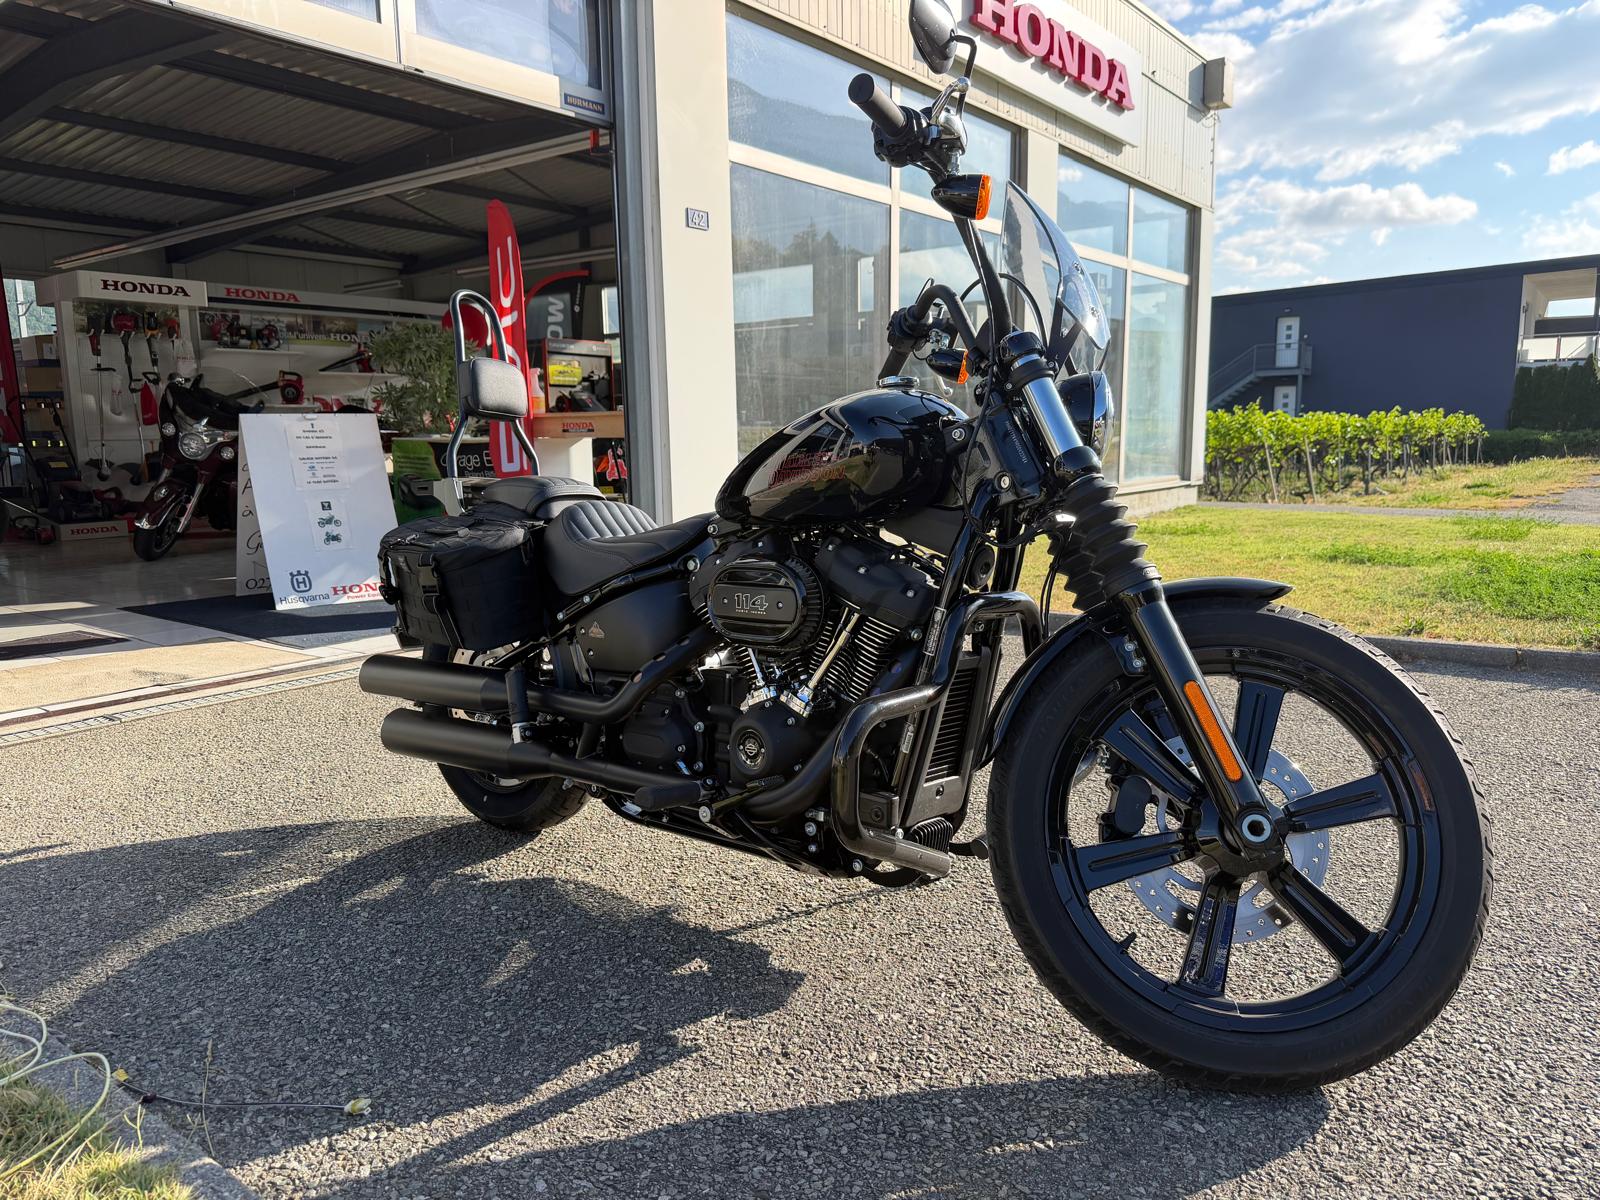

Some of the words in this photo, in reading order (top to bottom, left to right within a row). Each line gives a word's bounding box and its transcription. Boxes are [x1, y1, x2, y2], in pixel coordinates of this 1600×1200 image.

[969, 0, 1135, 111] HONDA
[690, 210, 706, 228] 42
[100, 279, 191, 297] HONDA
[224, 287, 301, 302] HONDA
[330, 332, 372, 344] HOND
[440, 452, 481, 470] Grage
[70, 525, 119, 535] HONDA
[331, 582, 385, 596] HON
[279, 592, 330, 605] Husqvarna
[734, 592, 769, 611] 114
